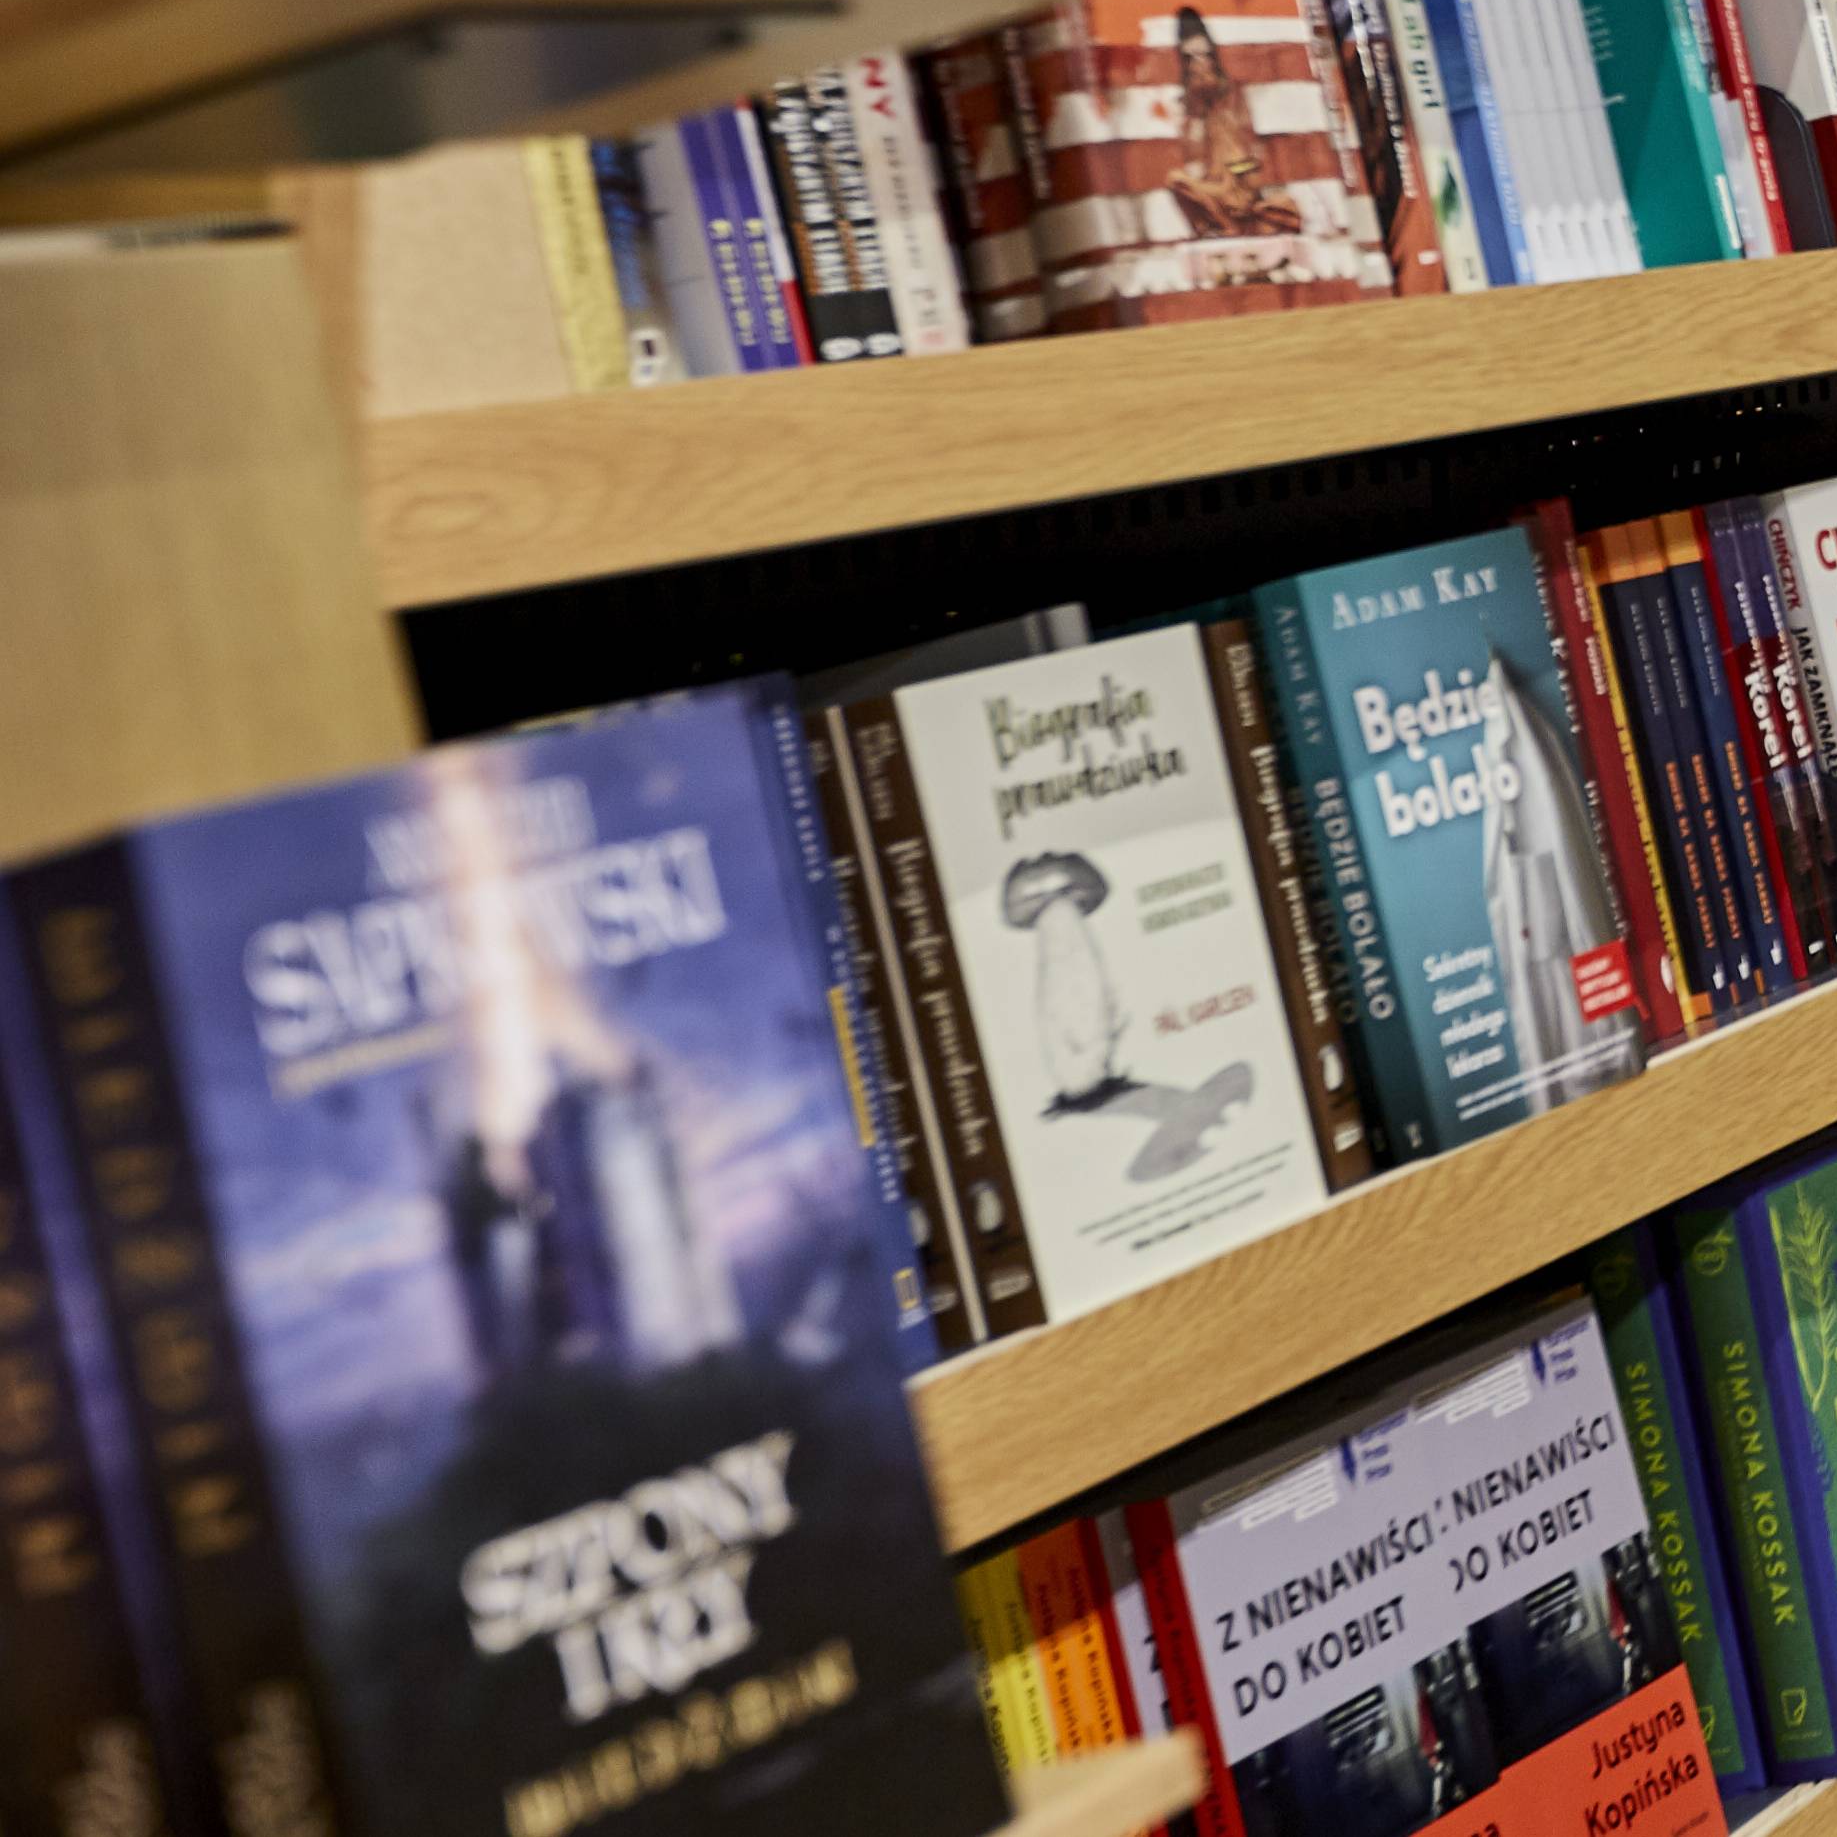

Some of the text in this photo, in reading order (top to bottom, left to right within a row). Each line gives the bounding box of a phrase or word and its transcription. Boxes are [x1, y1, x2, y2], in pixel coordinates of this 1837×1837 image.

[1330, 564, 1500, 632] ADAM KAY
[1767, 518, 1802, 611] CHIŃCZYK
[1791, 626, 1815, 664] JAK
[1351, 662, 1505, 756] Będzie
[1312, 777, 1367, 905] BĘDZIE
[1375, 760, 1524, 841] bolało
[1339, 907, 1397, 1021] BOLAŁO
[1451, 1414, 1619, 1524] NIENAWIŚCI
[1623, 1361, 1703, 1645] SIMONA KOSSAK
[1722, 1341, 1799, 1627] SIMONA KOSSAK
[1215, 1509, 1436, 1655] Z NIENAWIŚCI
[1233, 1594, 1408, 1720] DO KOBIET
[1582, 1751, 1701, 1837] Kopińska
[1588, 1696, 1688, 1778] Justyna
